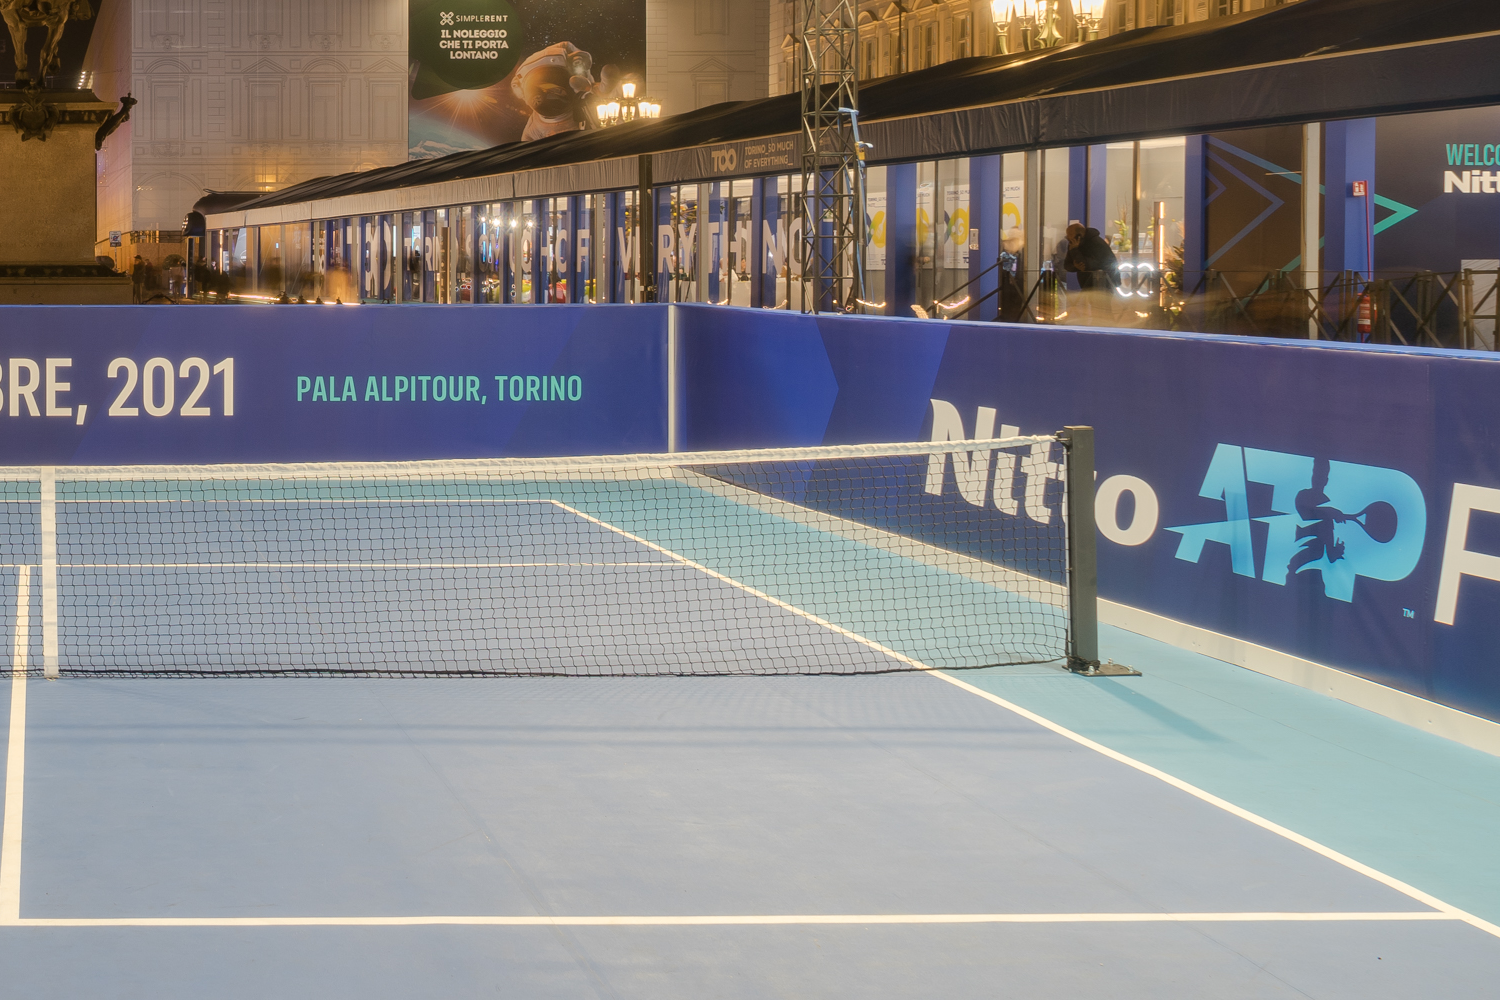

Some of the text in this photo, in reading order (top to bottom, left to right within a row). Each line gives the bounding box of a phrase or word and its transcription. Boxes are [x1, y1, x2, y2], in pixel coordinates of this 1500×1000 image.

[440, 29, 507, 38] IL NOLEGGIO
[439, 40, 508, 49] CHE TI PORTA
[450, 50, 498, 60] LONTANO
[776, 140, 794, 152] MUCH
[744, 158, 752, 169] OF
[1443, 169, 1500, 193] Nit
[107, 357, 234, 417] 2021
[297, 375, 583, 405] PALA ALPITOUR, TORINO
[924, 398, 1159, 547] Nito
[1163, 443, 1427, 603] ATP
